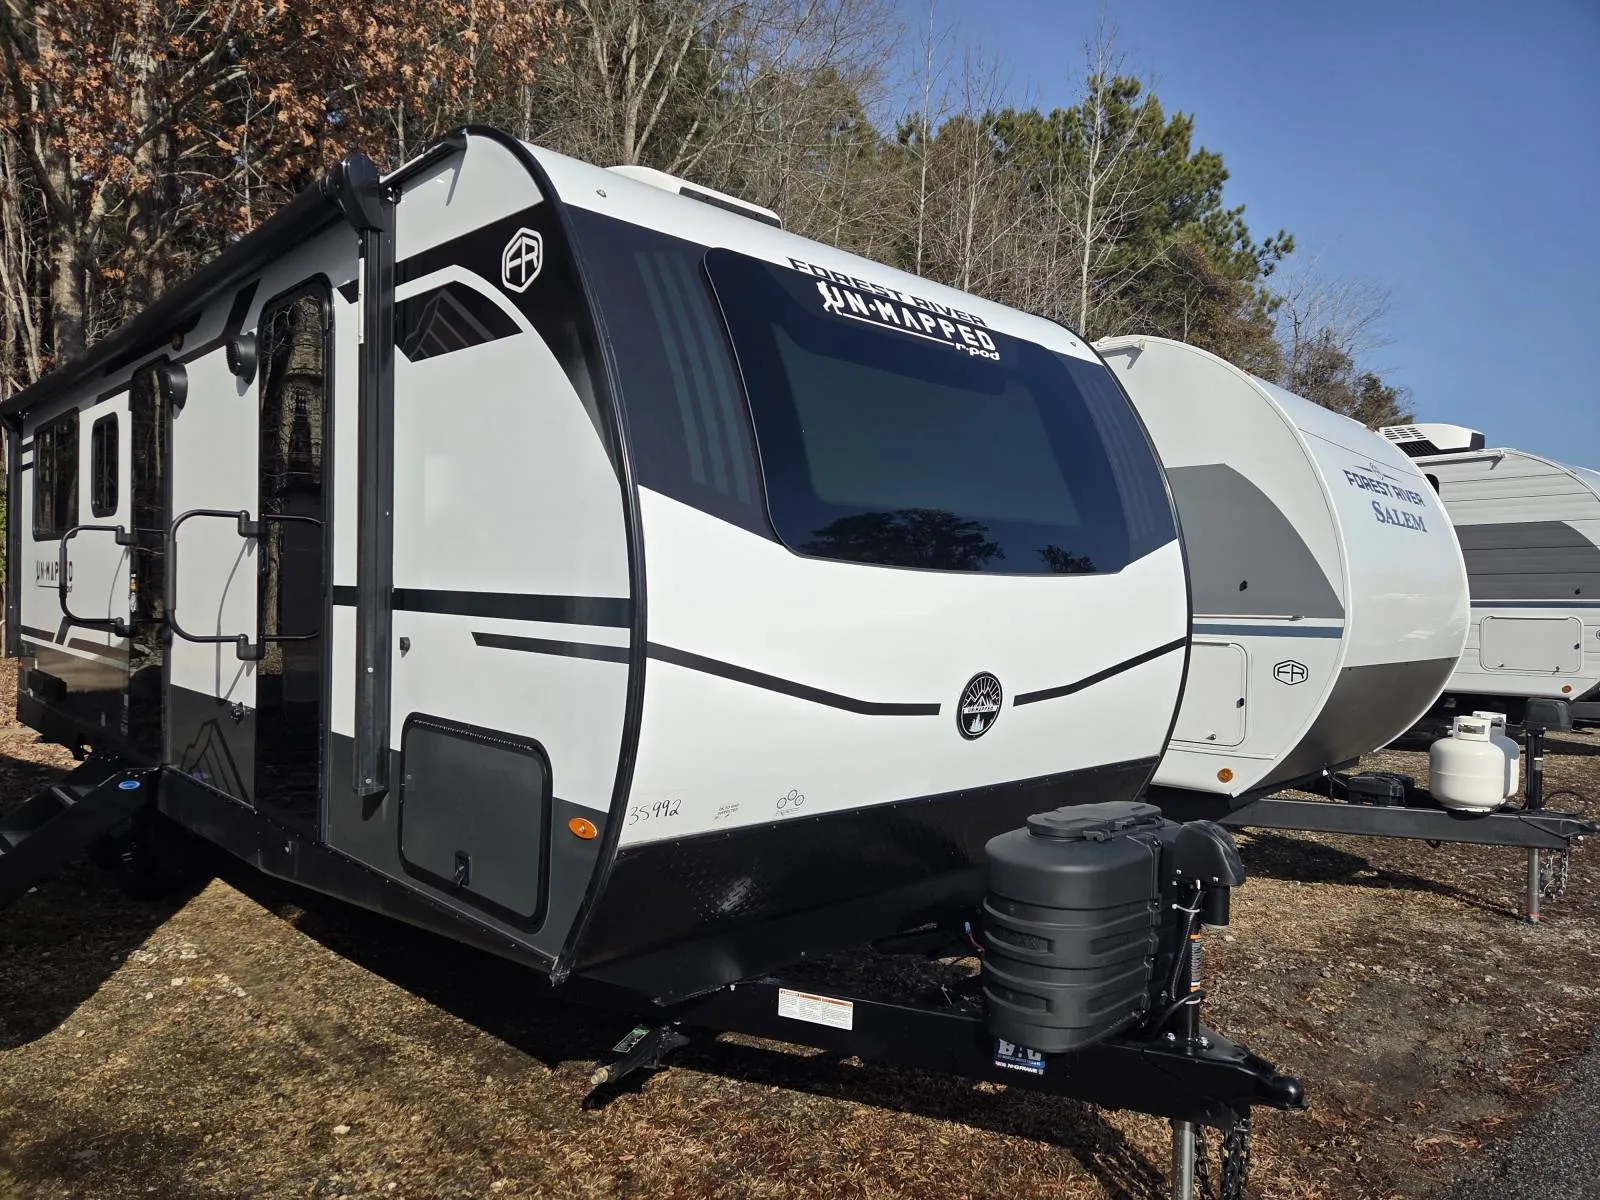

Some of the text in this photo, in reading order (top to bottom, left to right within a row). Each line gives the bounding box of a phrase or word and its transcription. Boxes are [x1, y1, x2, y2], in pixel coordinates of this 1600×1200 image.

[786, 256, 988, 327] FOREST RIVER
[1342, 469, 1426, 507] FOREST RIVER
[1371, 500, 1427, 533] SALEM
[628, 799, 682, 825] 35992
